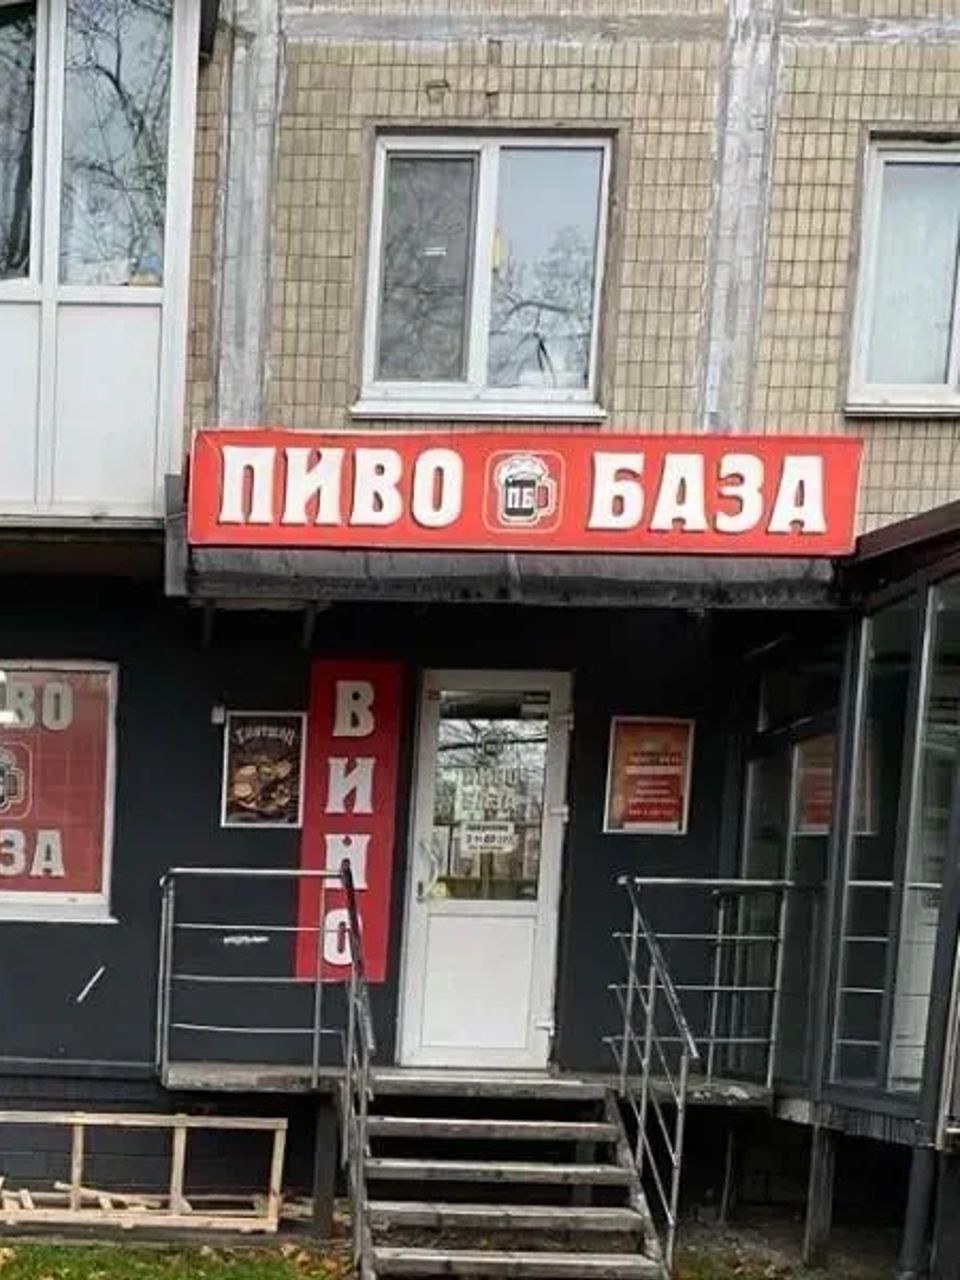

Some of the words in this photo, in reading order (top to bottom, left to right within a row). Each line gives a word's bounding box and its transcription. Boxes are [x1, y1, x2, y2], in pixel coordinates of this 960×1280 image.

[219, 446, 464, 528] ПИВО
[506, 486, 535, 509] ПБ
[587, 452, 827, 534] БАЗА
[324, 679, 377, 967] ВИНО
